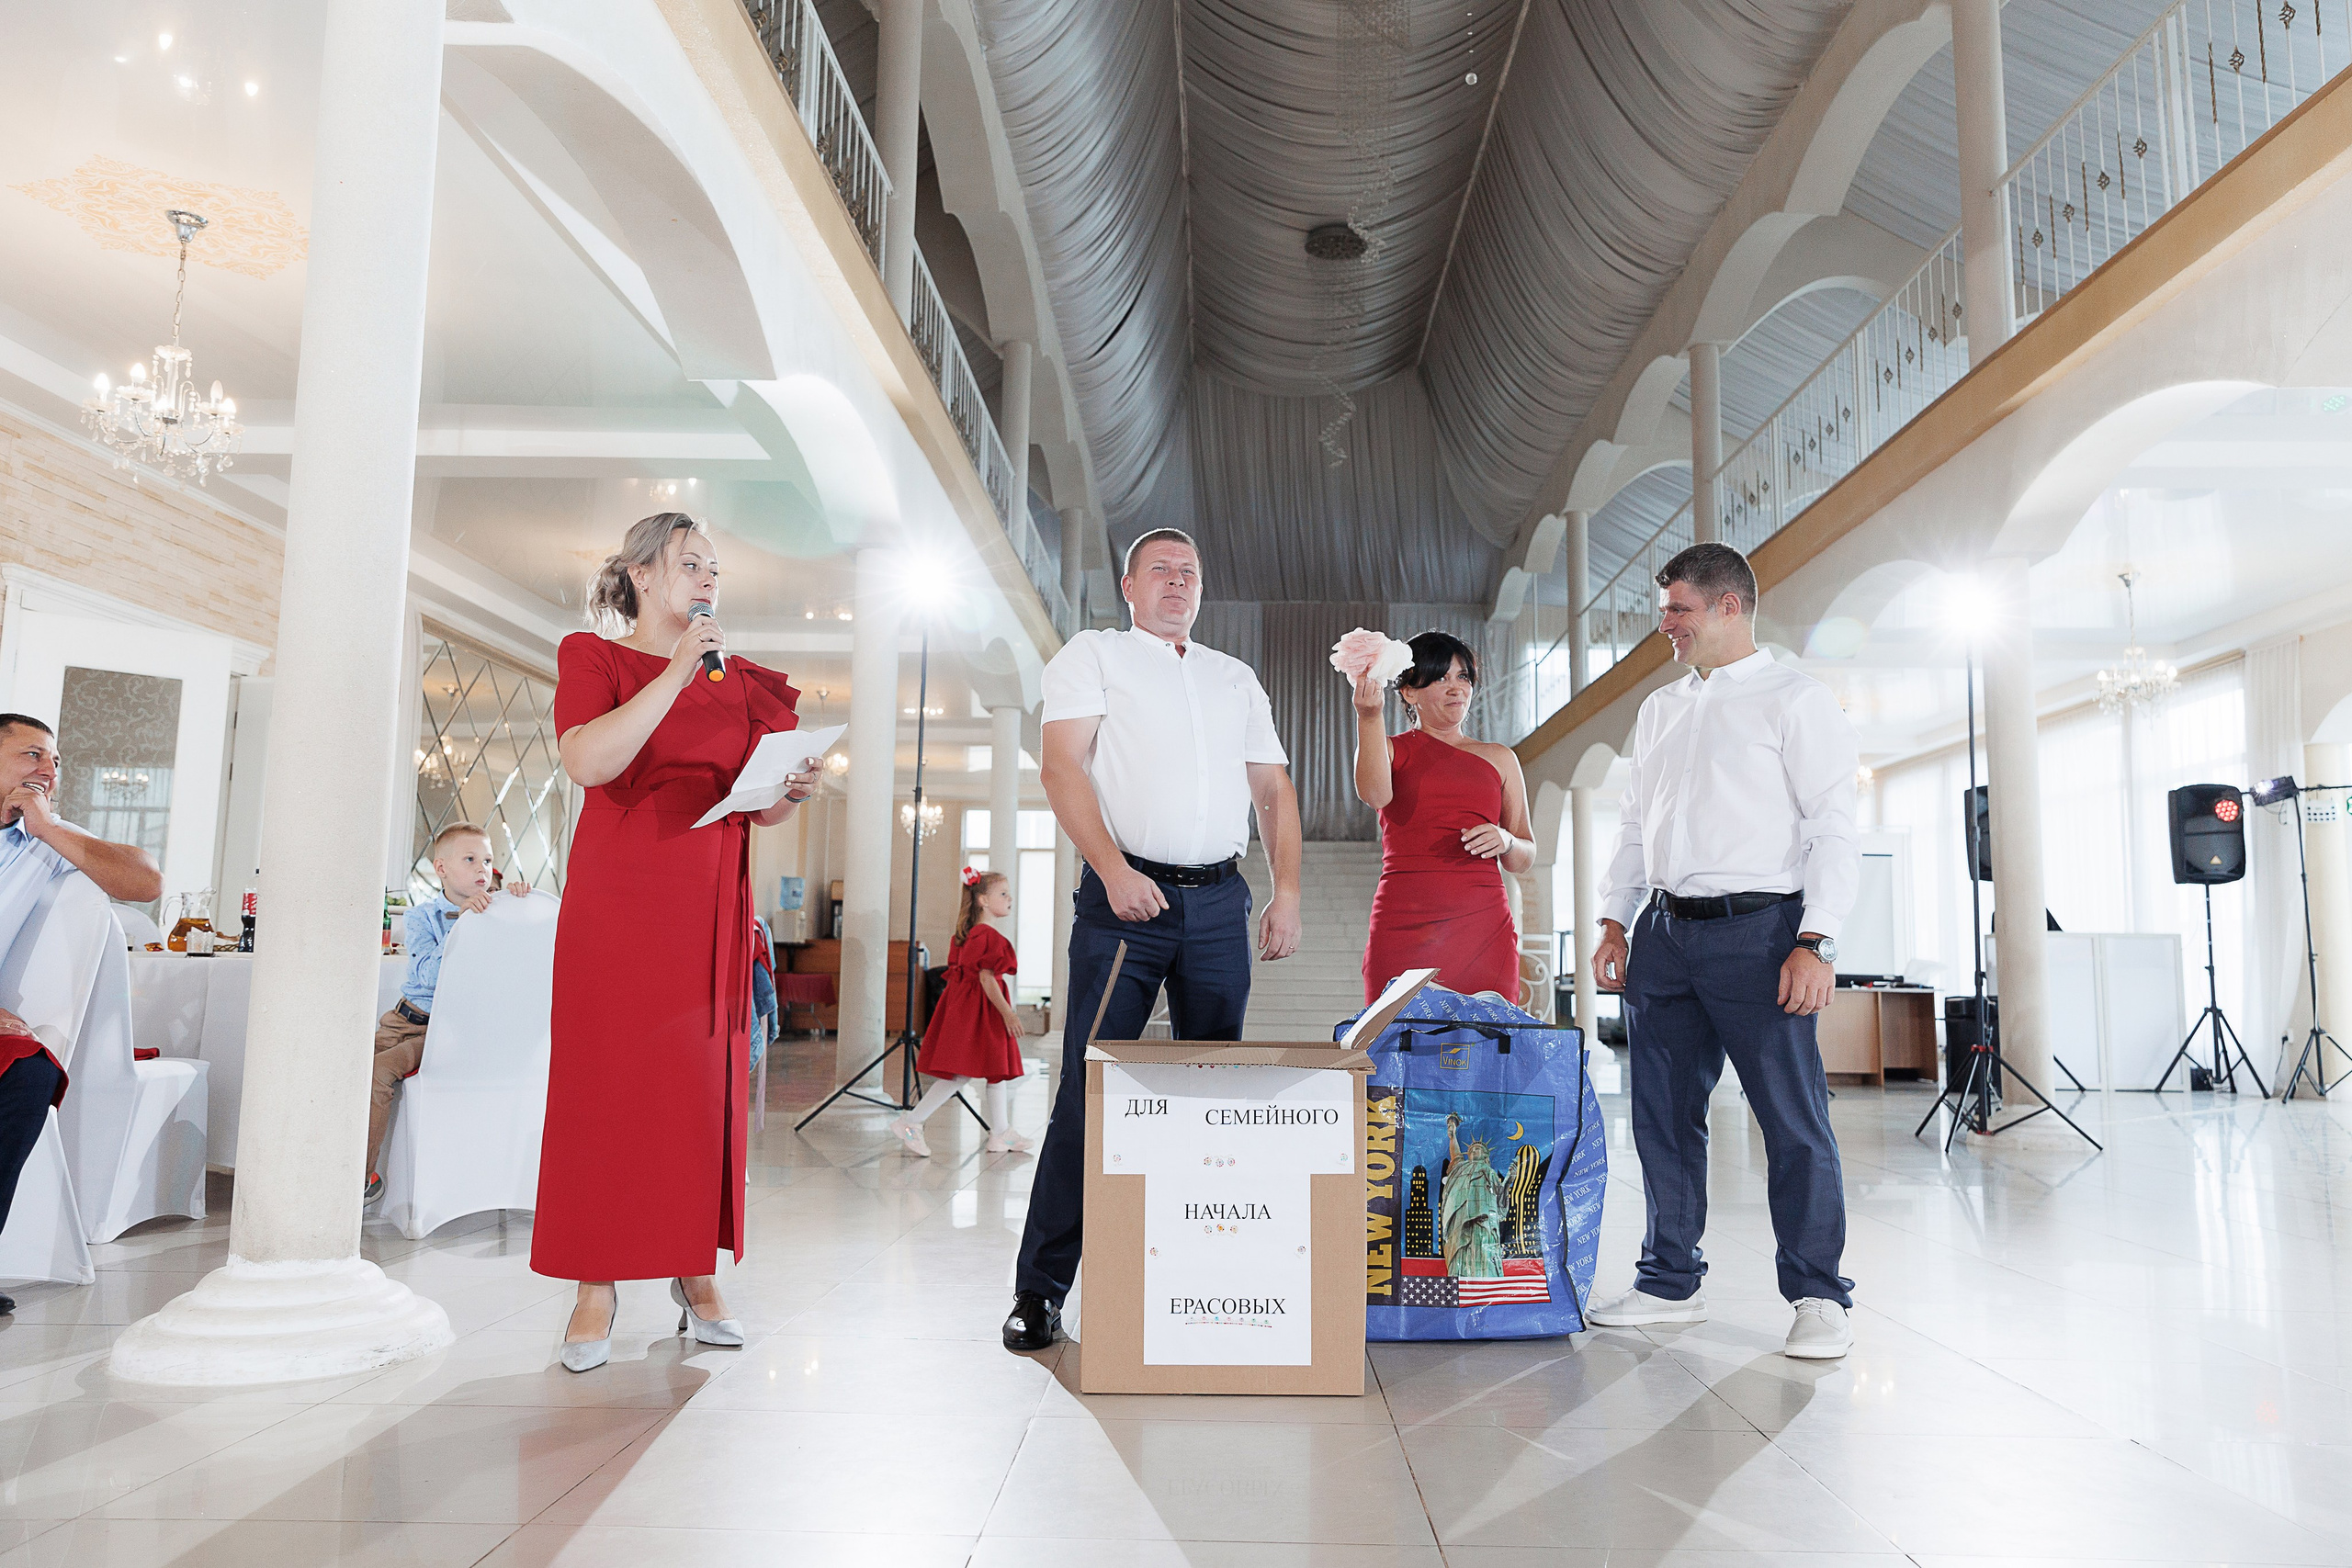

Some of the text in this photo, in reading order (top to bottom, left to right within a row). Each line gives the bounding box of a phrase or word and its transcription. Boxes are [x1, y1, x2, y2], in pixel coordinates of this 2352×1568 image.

[1125, 1100, 1339, 1125] ДЛЯ СЕМЕЙНОГО
[1573, 1184, 1592, 1199] YORK
[1184, 1203, 1272, 1220] НАЧАЛА
[1577, 1231, 1590, 1246] NEW
[1367, 1213, 1393, 1295] NEW
[1576, 1253, 1594, 1269] YORK
[1170, 1298, 1286, 1314] ЕРАСОВЫХ
